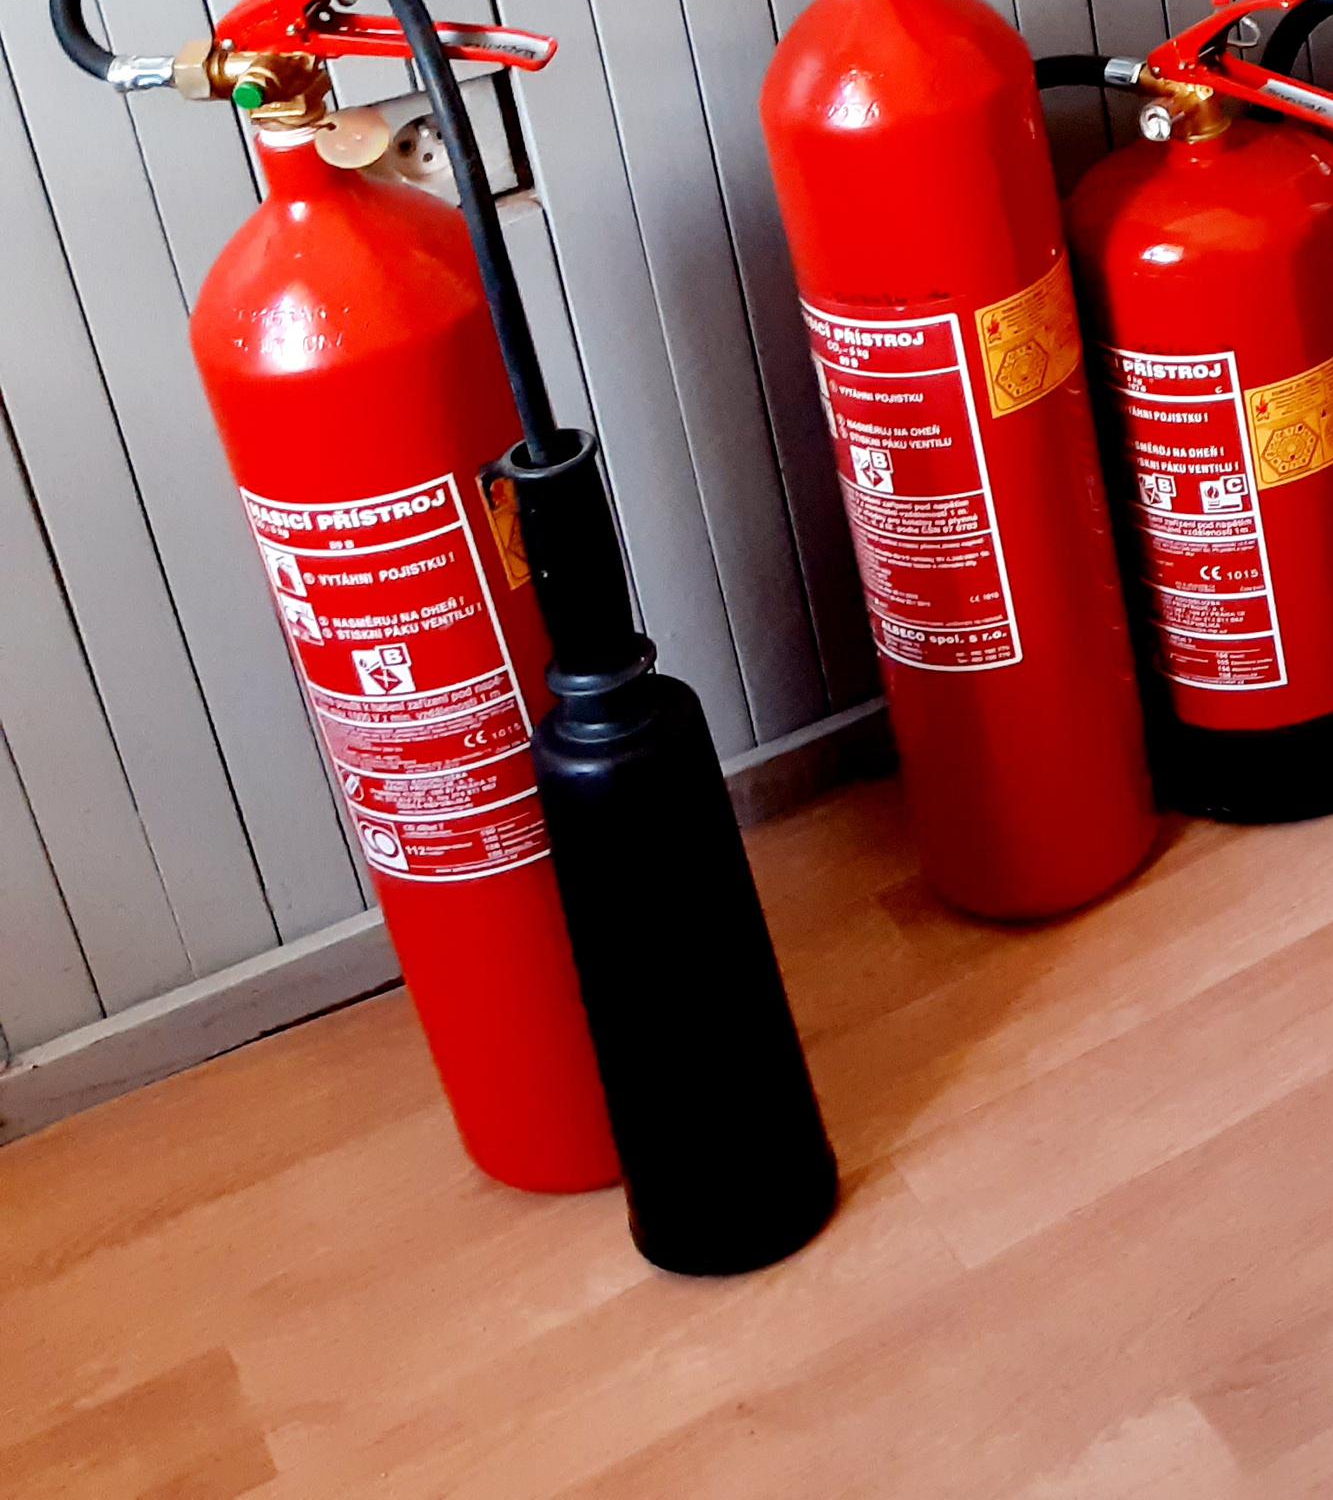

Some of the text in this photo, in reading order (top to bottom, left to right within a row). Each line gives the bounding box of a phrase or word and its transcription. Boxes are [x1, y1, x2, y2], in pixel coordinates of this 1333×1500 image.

[833, 327, 924, 346] PŘÍSTROJ
[1122, 359, 1221, 379] PŘÍSTROJ
[875, 393, 923, 403] POJISTKU
[1154, 412, 1202, 423] POJISTKU
[911, 425, 940, 436] OHEŇ
[882, 439, 907, 449] PÁKU
[909, 438, 952, 449] VENTILU
[1172, 446, 1218, 458] NA OHEŇ
[875, 452, 887, 468] B
[1161, 462, 1232, 474] PÁKU VENTILU
[1158, 478, 1170, 491] B
[1226, 478, 1242, 492] C
[249, 489, 445, 530] HASICÍ PŘÍSTROJ
[1198, 521, 1214, 529] pod
[379, 557, 446, 581] POJISTKU
[1227, 570, 1258, 579] 1015
[402, 612, 418, 623] NA
[421, 597, 457, 617] OHEŇ
[385, 623, 419, 638] PÁKU
[422, 606, 474, 630] VENTILU
[929, 633, 963, 645] spol.
[982, 630, 1007, 641] r.o.
[386, 649, 403, 664] B
